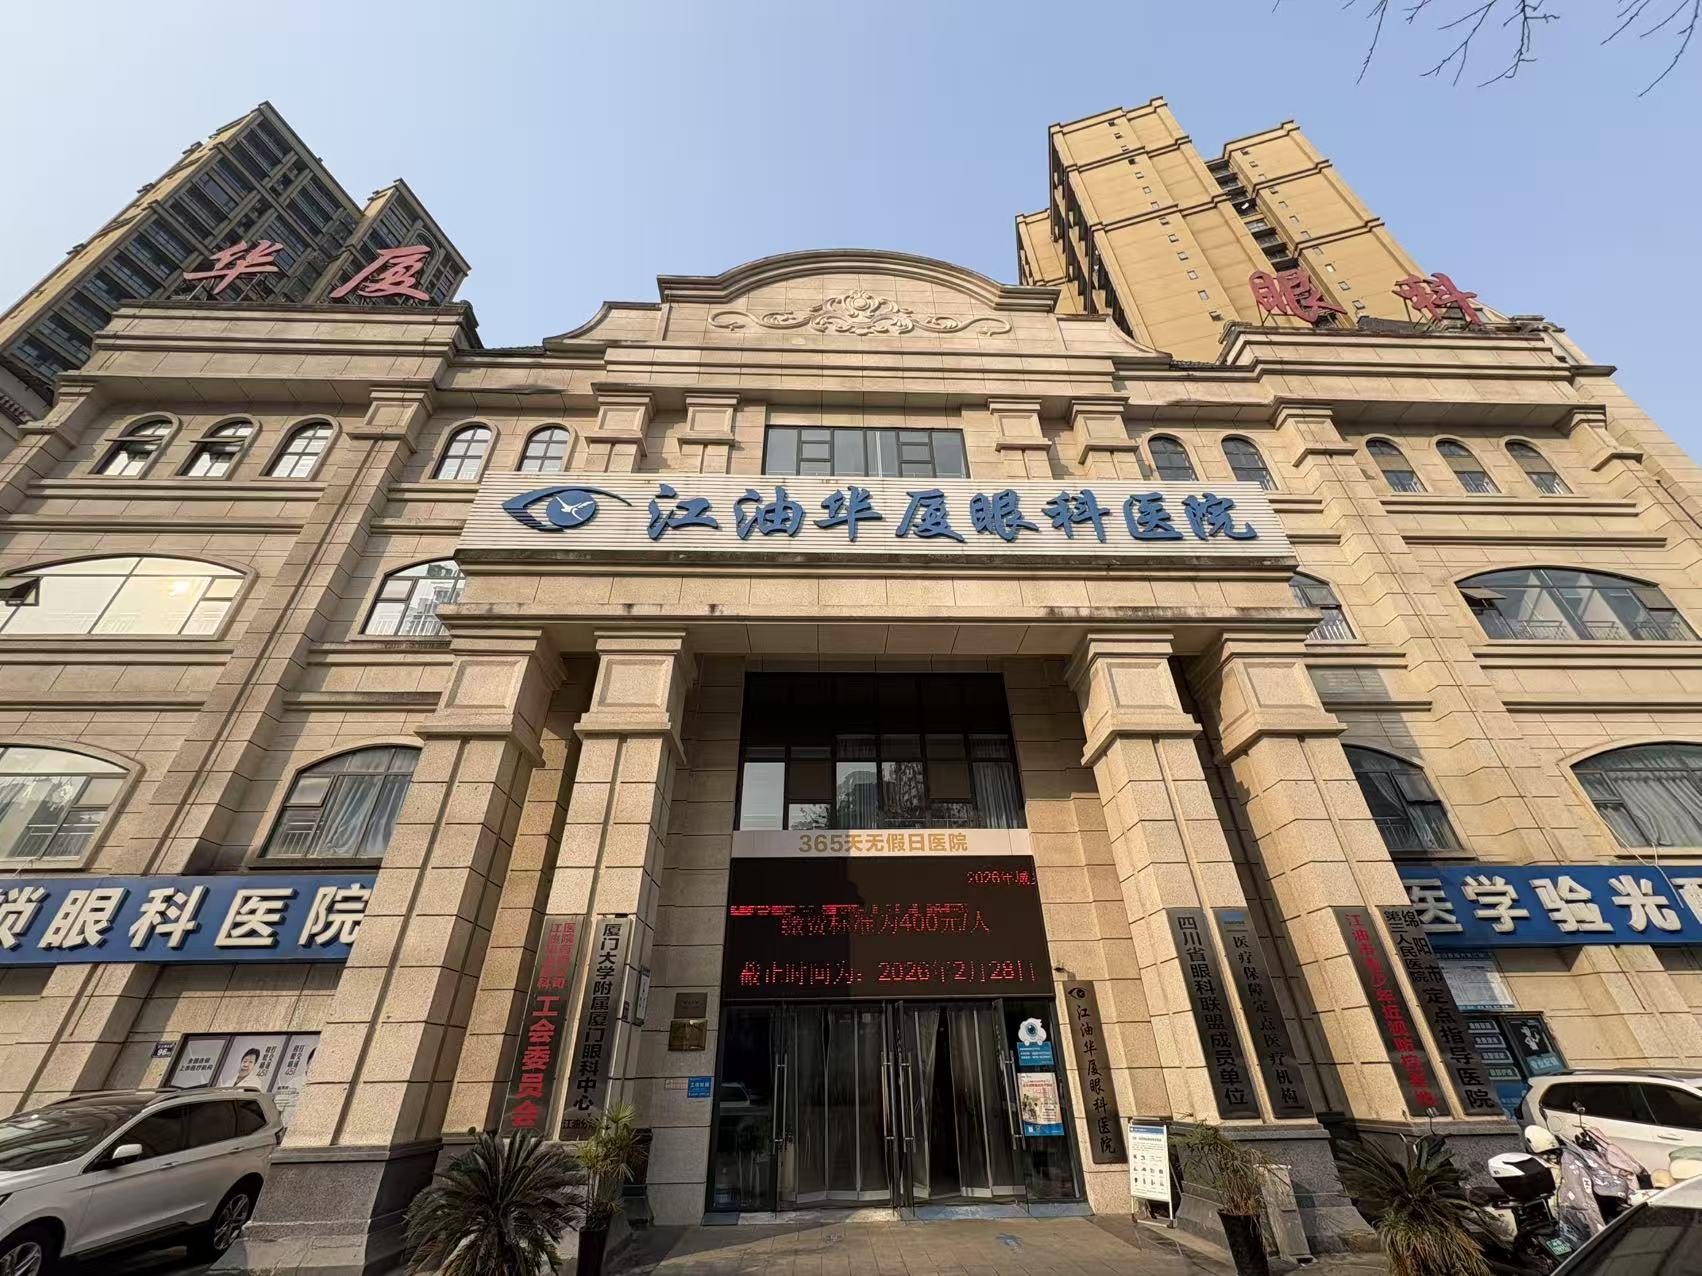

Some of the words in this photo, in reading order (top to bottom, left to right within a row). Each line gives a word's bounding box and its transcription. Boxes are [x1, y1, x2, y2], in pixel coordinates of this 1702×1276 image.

[183, 239, 432, 301] 华厦
[1249, 270, 1482, 327] 眼科
[647, 484, 1258, 543] 江油华厦眼科医院
[798, 832, 969, 853] 365天无假日医院
[1384, 910, 1429, 983] 第三人民医院
[1401, 911, 1443, 983] 绵阳市
[574, 922, 623, 1111] 厦门大学附属厦门眼科中心
[1176, 916, 1249, 1106] 四川省眼科联盟成员单位
[1232, 936, 1298, 1105] 医疗保障定点医疗机构
[1424, 987, 1495, 1108] 定点指导医院
[511, 996, 561, 1128] 工会委员会
[1076, 1005, 1116, 1154] 江油华厦眼科医院
